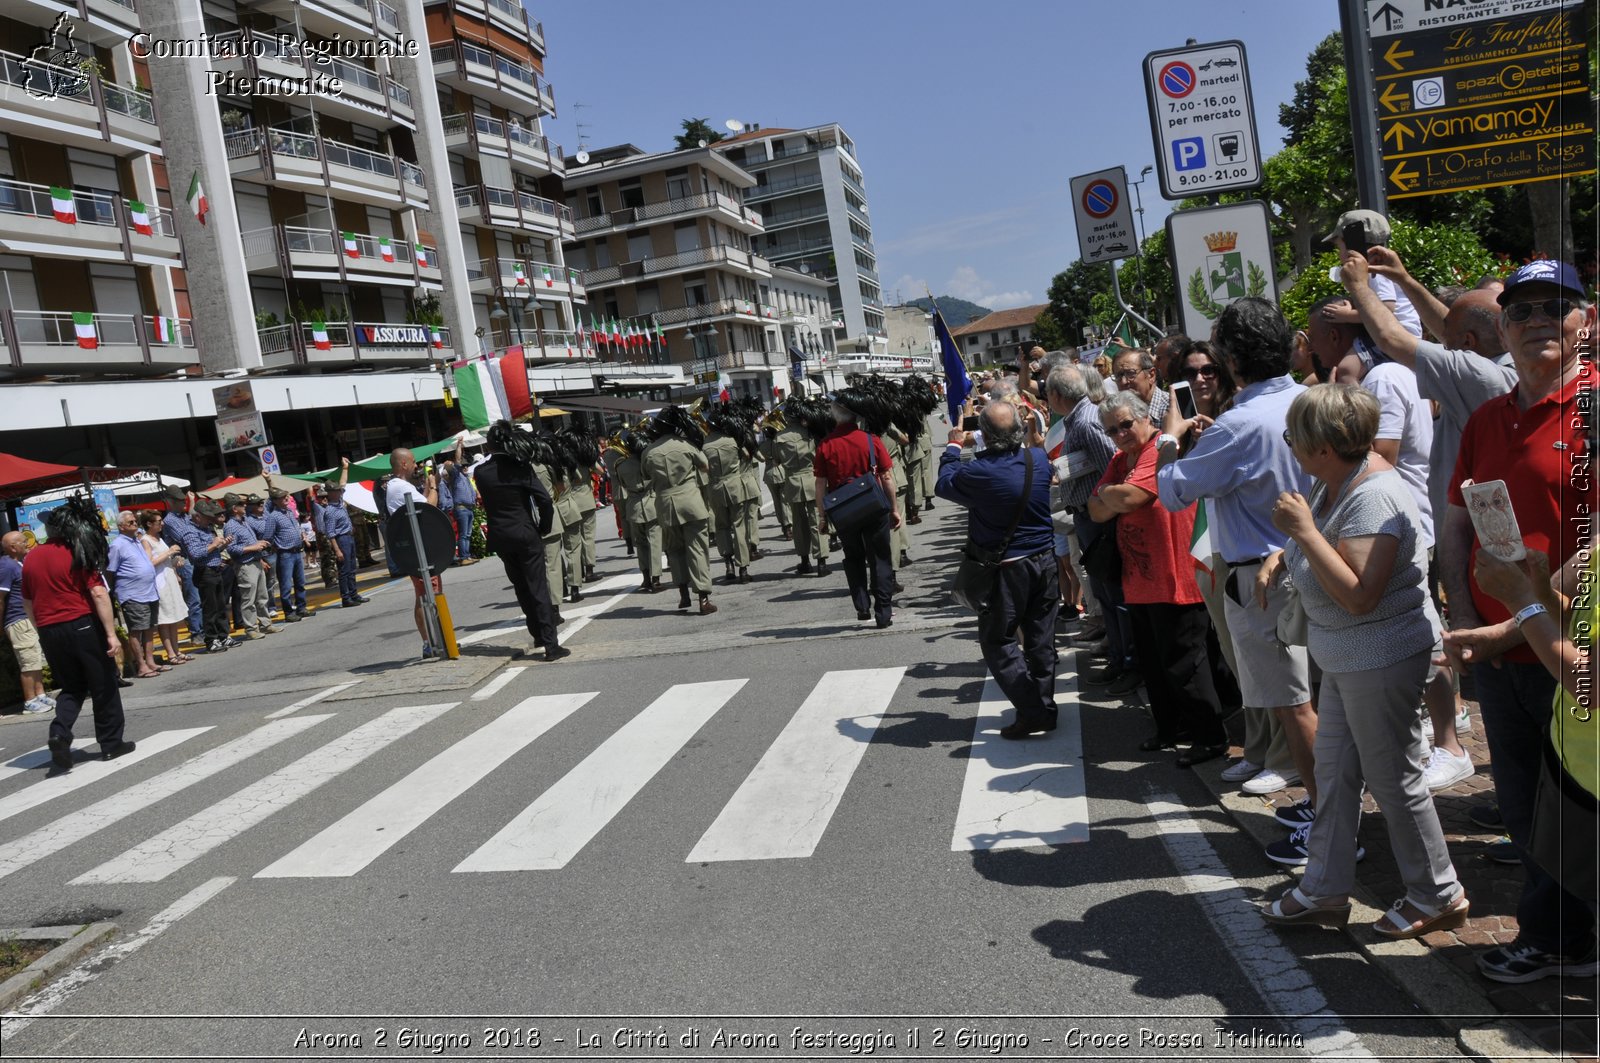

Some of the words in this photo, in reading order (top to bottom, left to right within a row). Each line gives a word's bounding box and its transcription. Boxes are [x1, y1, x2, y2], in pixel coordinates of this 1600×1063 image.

[1418, 7, 1500, 26] RISTORANTE
[1443, 27, 1475, 51] Le
[1481, 11, 1569, 47] Farfalle
[1444, 47, 1517, 64] ABBIGLIAMENTO
[1527, 38, 1572, 51] BAMBINO
[1169, 117, 1187, 128] per
[1193, 108, 1241, 123] mercato
[1495, 132, 1518, 141] VIA
[1522, 122, 1585, 137] CAVOUR
[1179, 142, 1199, 167] P
[1506, 150, 1531, 163] della
[1537, 142, 1585, 161] Ruga
